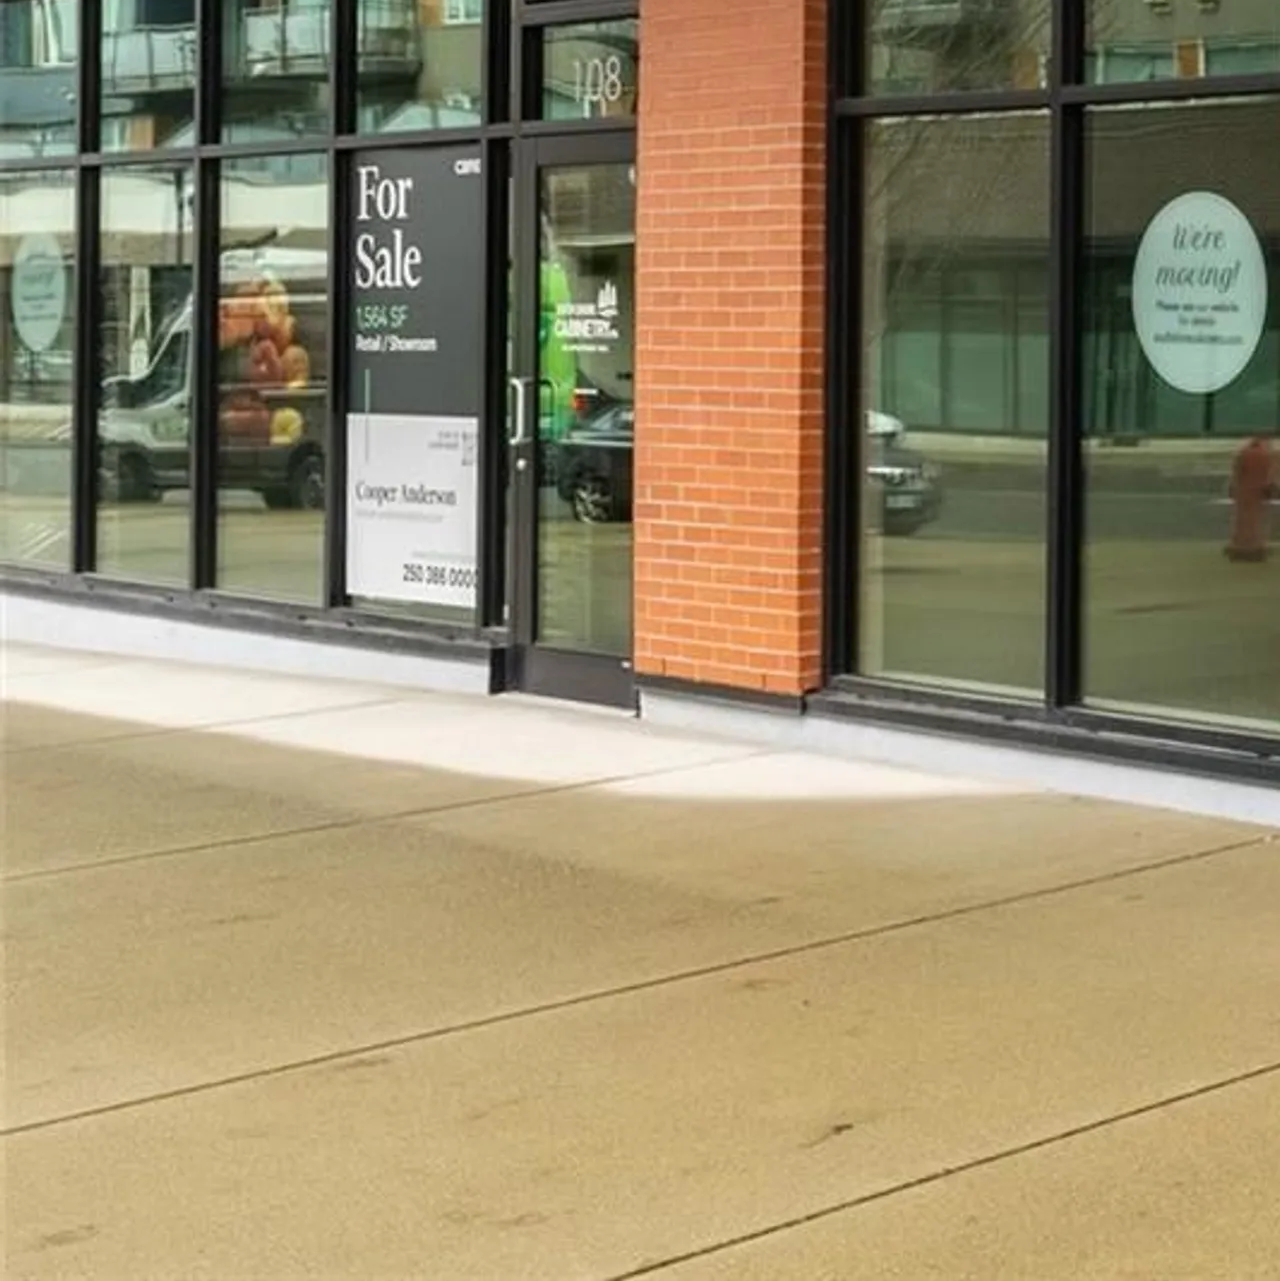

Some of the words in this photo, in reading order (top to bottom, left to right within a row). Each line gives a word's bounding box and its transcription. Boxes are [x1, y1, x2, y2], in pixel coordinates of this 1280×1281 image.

[573, 56, 621, 102] 108
[357, 165, 413, 220] For
[355, 228, 422, 288] Sale
[1155, 259, 1242, 294] moving!
[390, 304, 409, 328] SF
[355, 481, 398, 508] Cooper
[401, 482, 458, 506] Anderson
